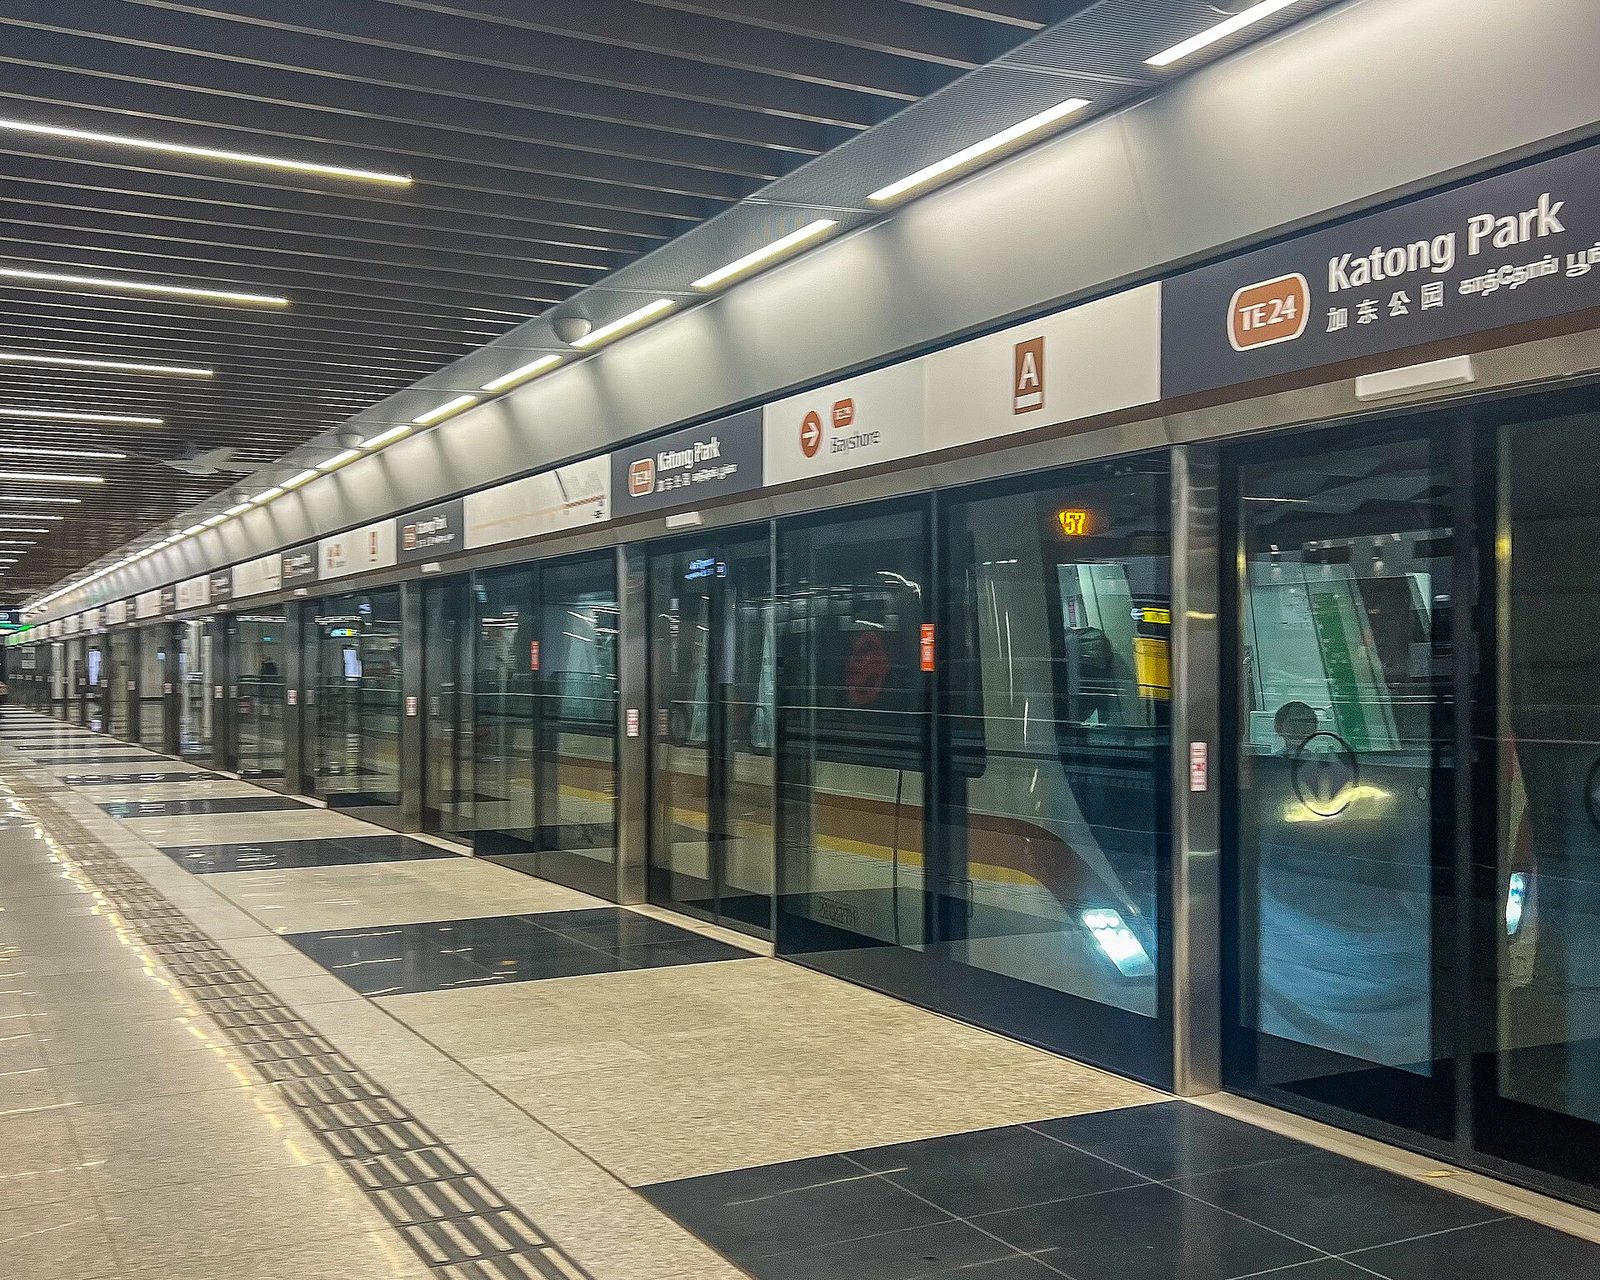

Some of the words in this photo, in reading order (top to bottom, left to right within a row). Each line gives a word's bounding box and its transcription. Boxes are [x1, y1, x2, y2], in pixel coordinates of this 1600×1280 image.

[1328, 232, 1456, 293] Katong
[1467, 192, 1566, 256] Park
[1239, 294, 1298, 332] TE24
[1018, 352, 1040, 390] A
